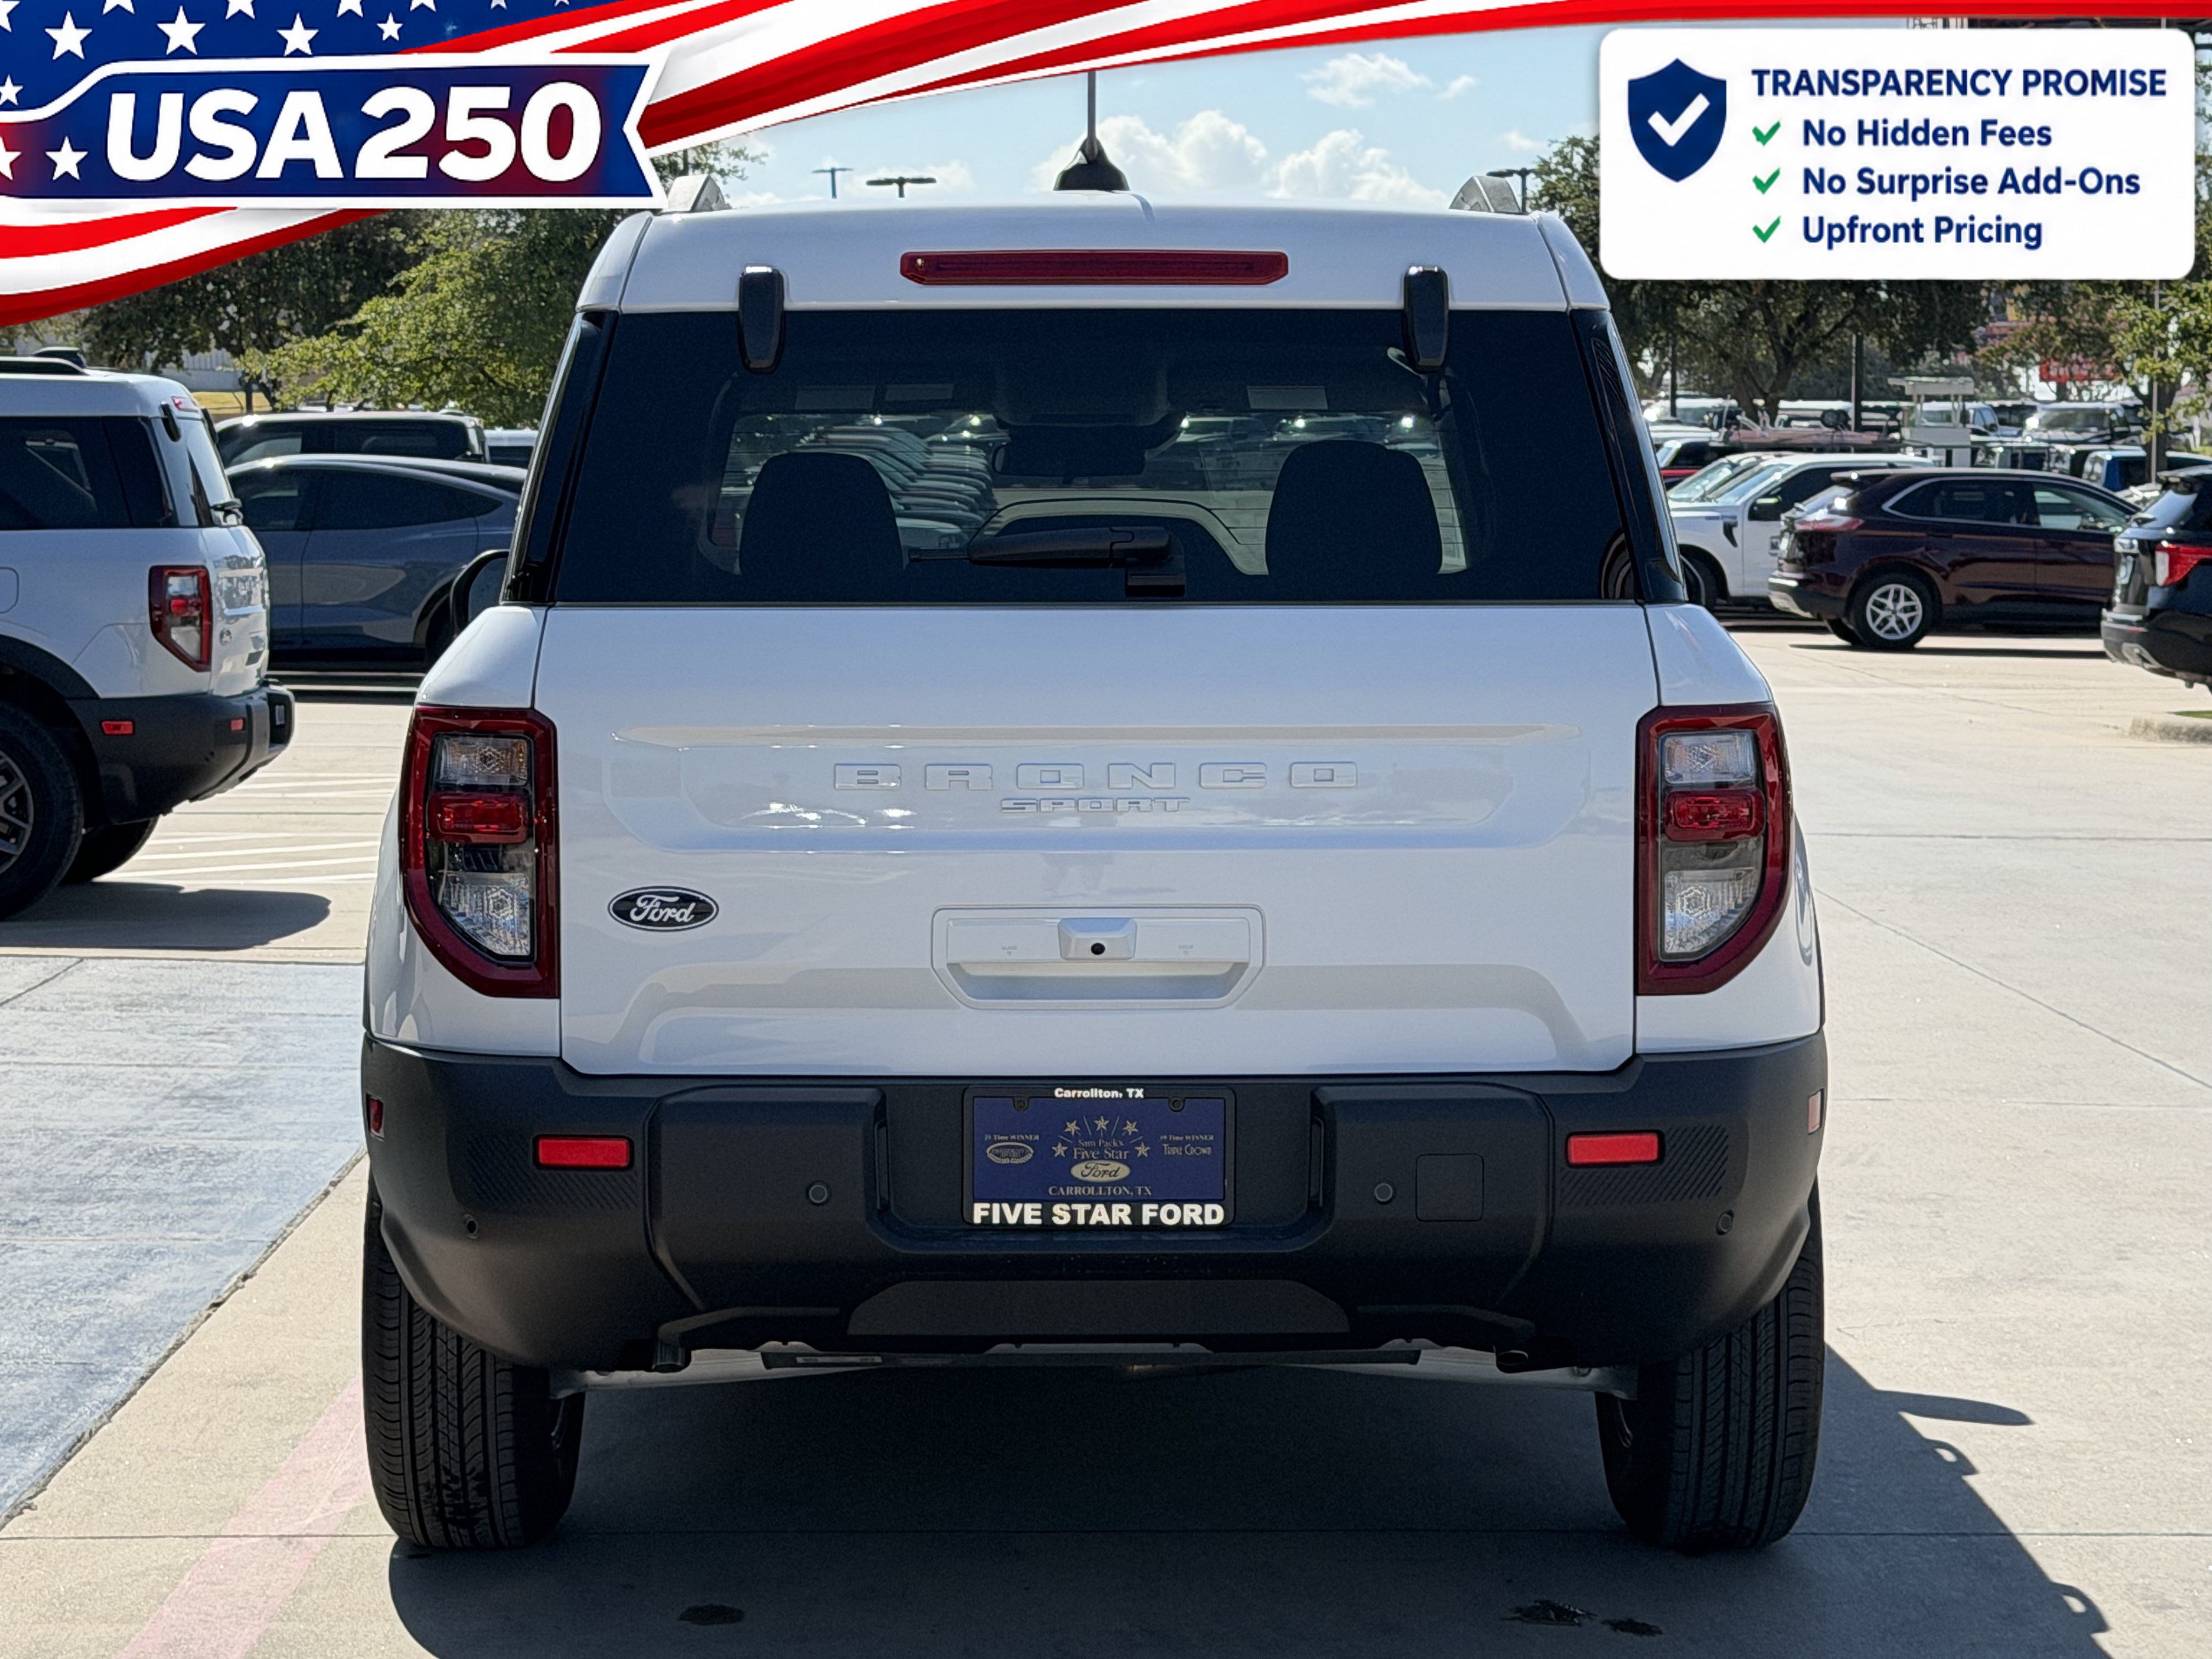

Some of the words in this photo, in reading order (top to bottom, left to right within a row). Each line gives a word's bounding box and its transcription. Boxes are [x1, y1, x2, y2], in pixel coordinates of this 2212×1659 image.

[834, 761, 1357, 791] BRONCO
[1001, 797, 1190, 813] SPORT
[630, 894, 696, 922] Ford
[1054, 1088, 1123, 1099] Carrollton,
[1126, 1088, 1144, 1098] TX
[1073, 1147, 1099, 1159] Five
[1104, 1147, 1129, 1159] Star
[1081, 1162, 1120, 1178] Ford
[1048, 1186, 1133, 1197] CARROLLTON,
[1136, 1186, 1152, 1196] TX
[973, 1203, 1042, 1224] FIVE
[1052, 1203, 1132, 1225] STAR
[1142, 1203, 1224, 1226] FORD
